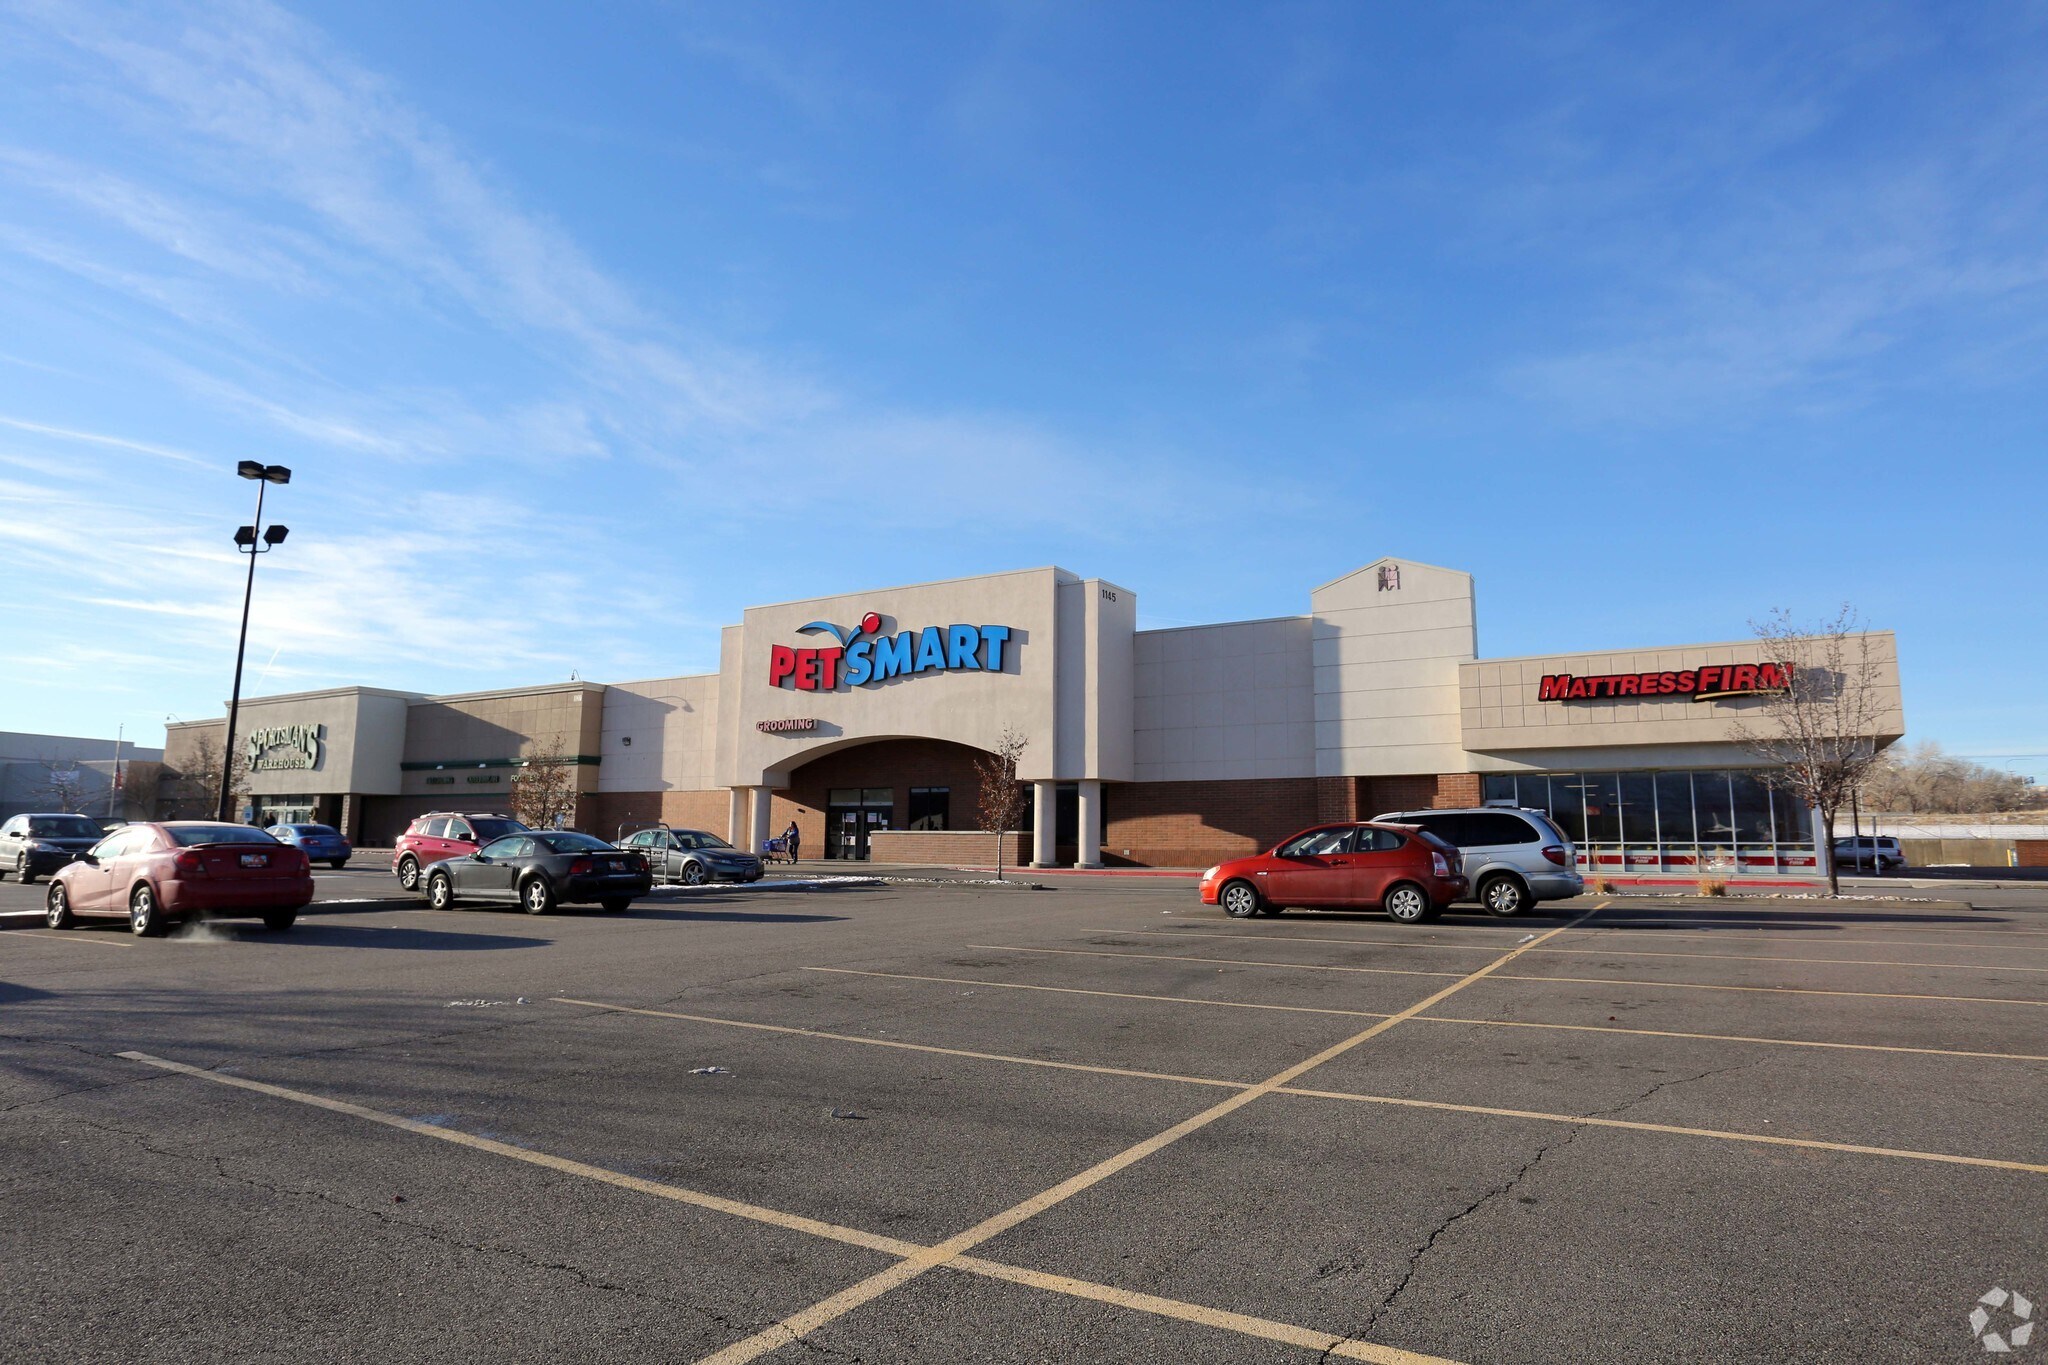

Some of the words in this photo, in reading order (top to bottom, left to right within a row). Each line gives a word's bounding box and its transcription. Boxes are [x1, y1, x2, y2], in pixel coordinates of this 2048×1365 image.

[1102, 589, 1116, 603] 1145
[769, 624, 1009, 690] PETSMART
[1539, 671, 1696, 699] MATTRESS
[1698, 662, 1794, 692] FIRM
[756, 719, 814, 732] GROOMING
[257, 758, 306, 769] WAREHOUSE
